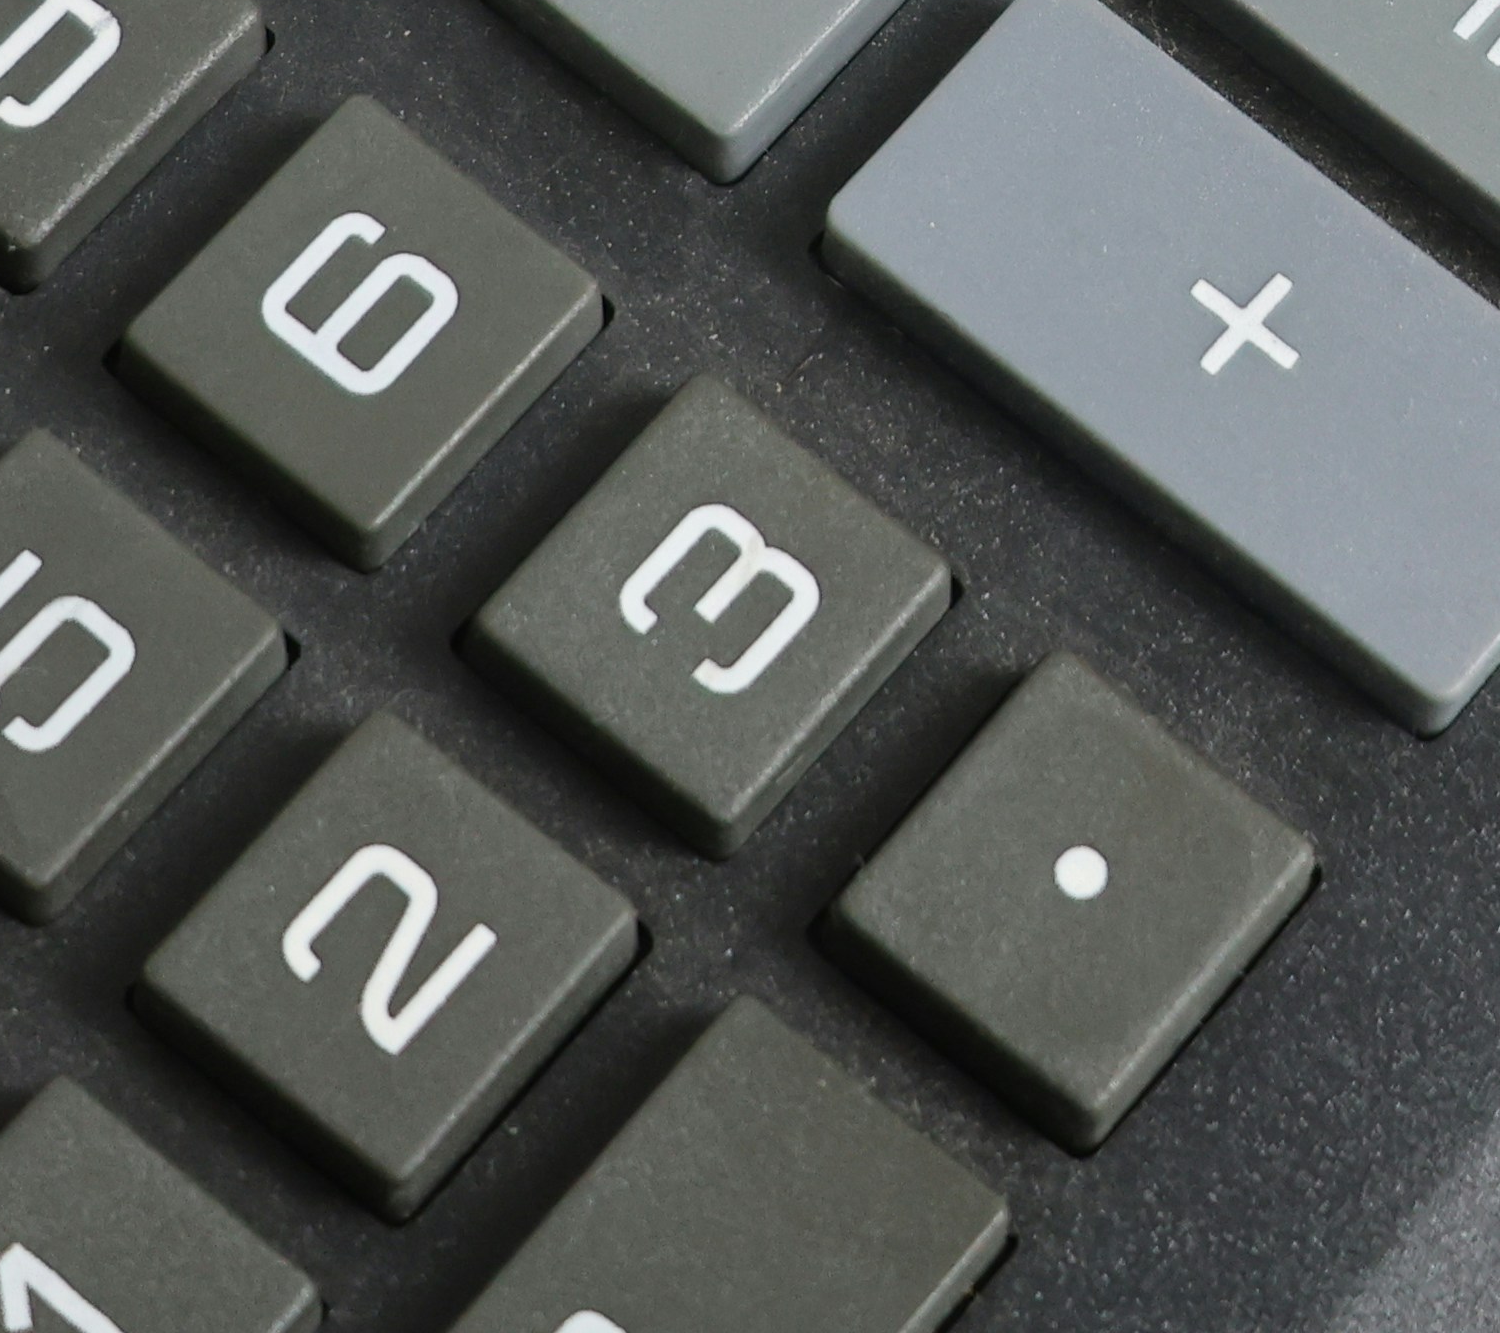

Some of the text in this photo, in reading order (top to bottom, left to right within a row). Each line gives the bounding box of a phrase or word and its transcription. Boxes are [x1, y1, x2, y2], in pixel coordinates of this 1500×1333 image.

[261, 211, 459, 395] 6
[1189, 272, 1301, 377] +
[618, 503, 820, 694] 3
[282, 844, 497, 1055] 2
